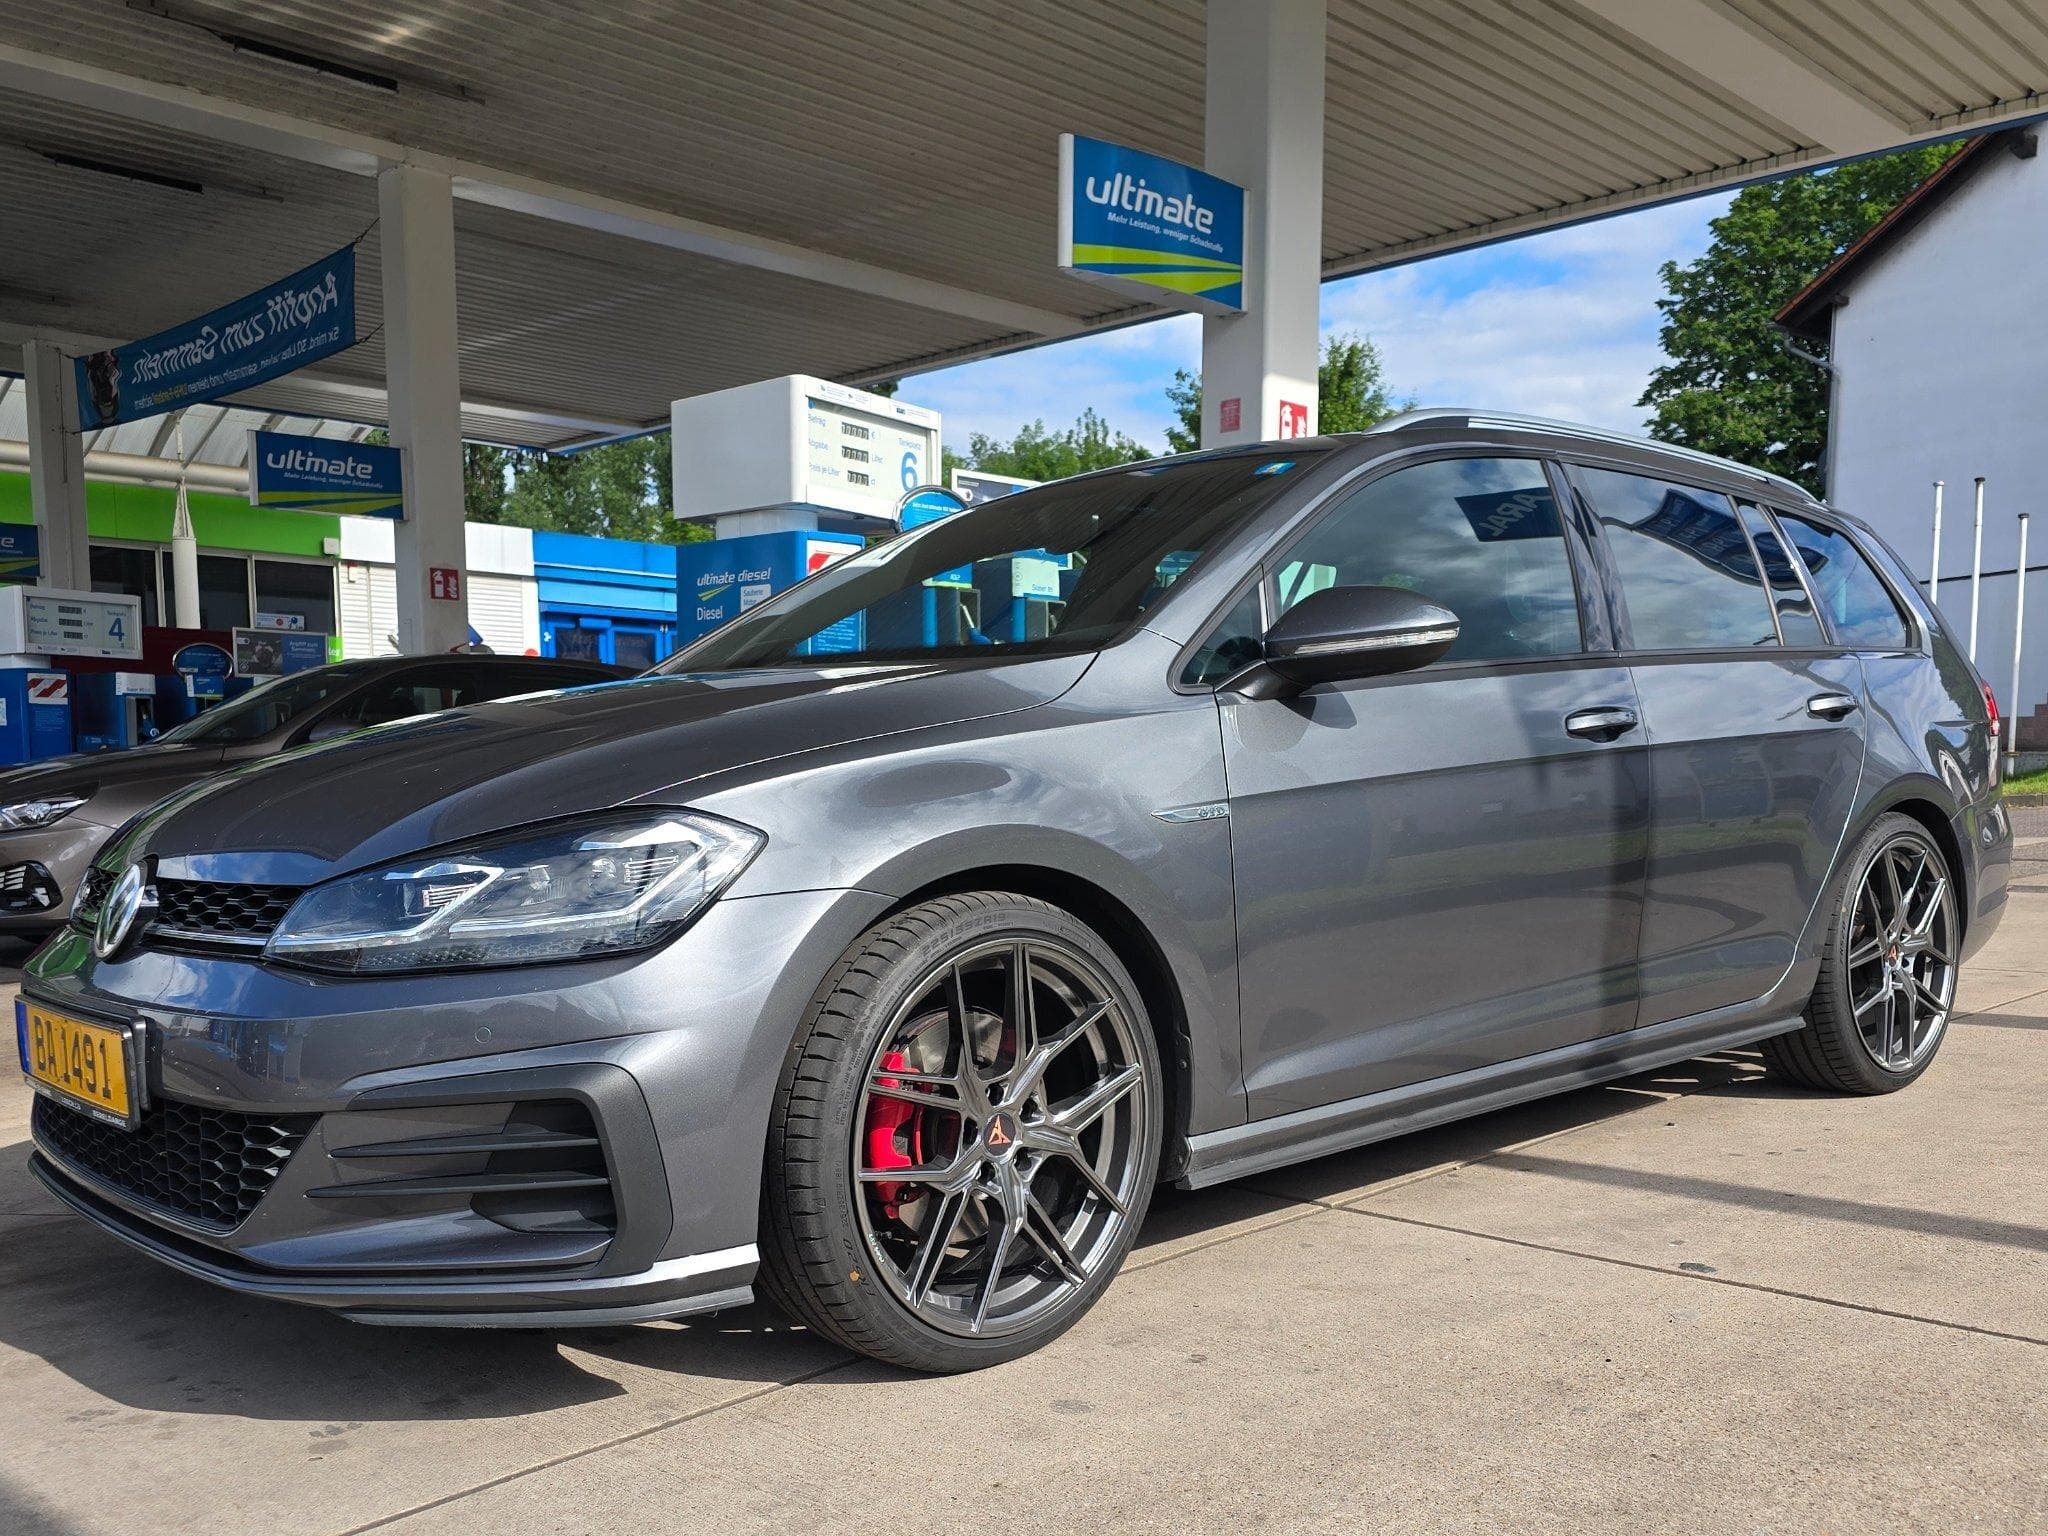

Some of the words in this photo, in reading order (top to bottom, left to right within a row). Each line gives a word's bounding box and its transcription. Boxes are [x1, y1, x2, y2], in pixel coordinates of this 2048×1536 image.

[1085, 172, 1214, 234] ultimate
[1107, 212, 1128, 224] Mehr
[1129, 217, 1161, 234] Leistung,
[1163, 227, 1189, 241] weniger
[266, 449, 373, 479] ultimate
[901, 451, 918, 492] 6
[697, 571, 735, 586] ultimate
[738, 566, 772, 582] diesel
[696, 605, 723, 620] Diesel
[108, 617, 125, 642] 4
